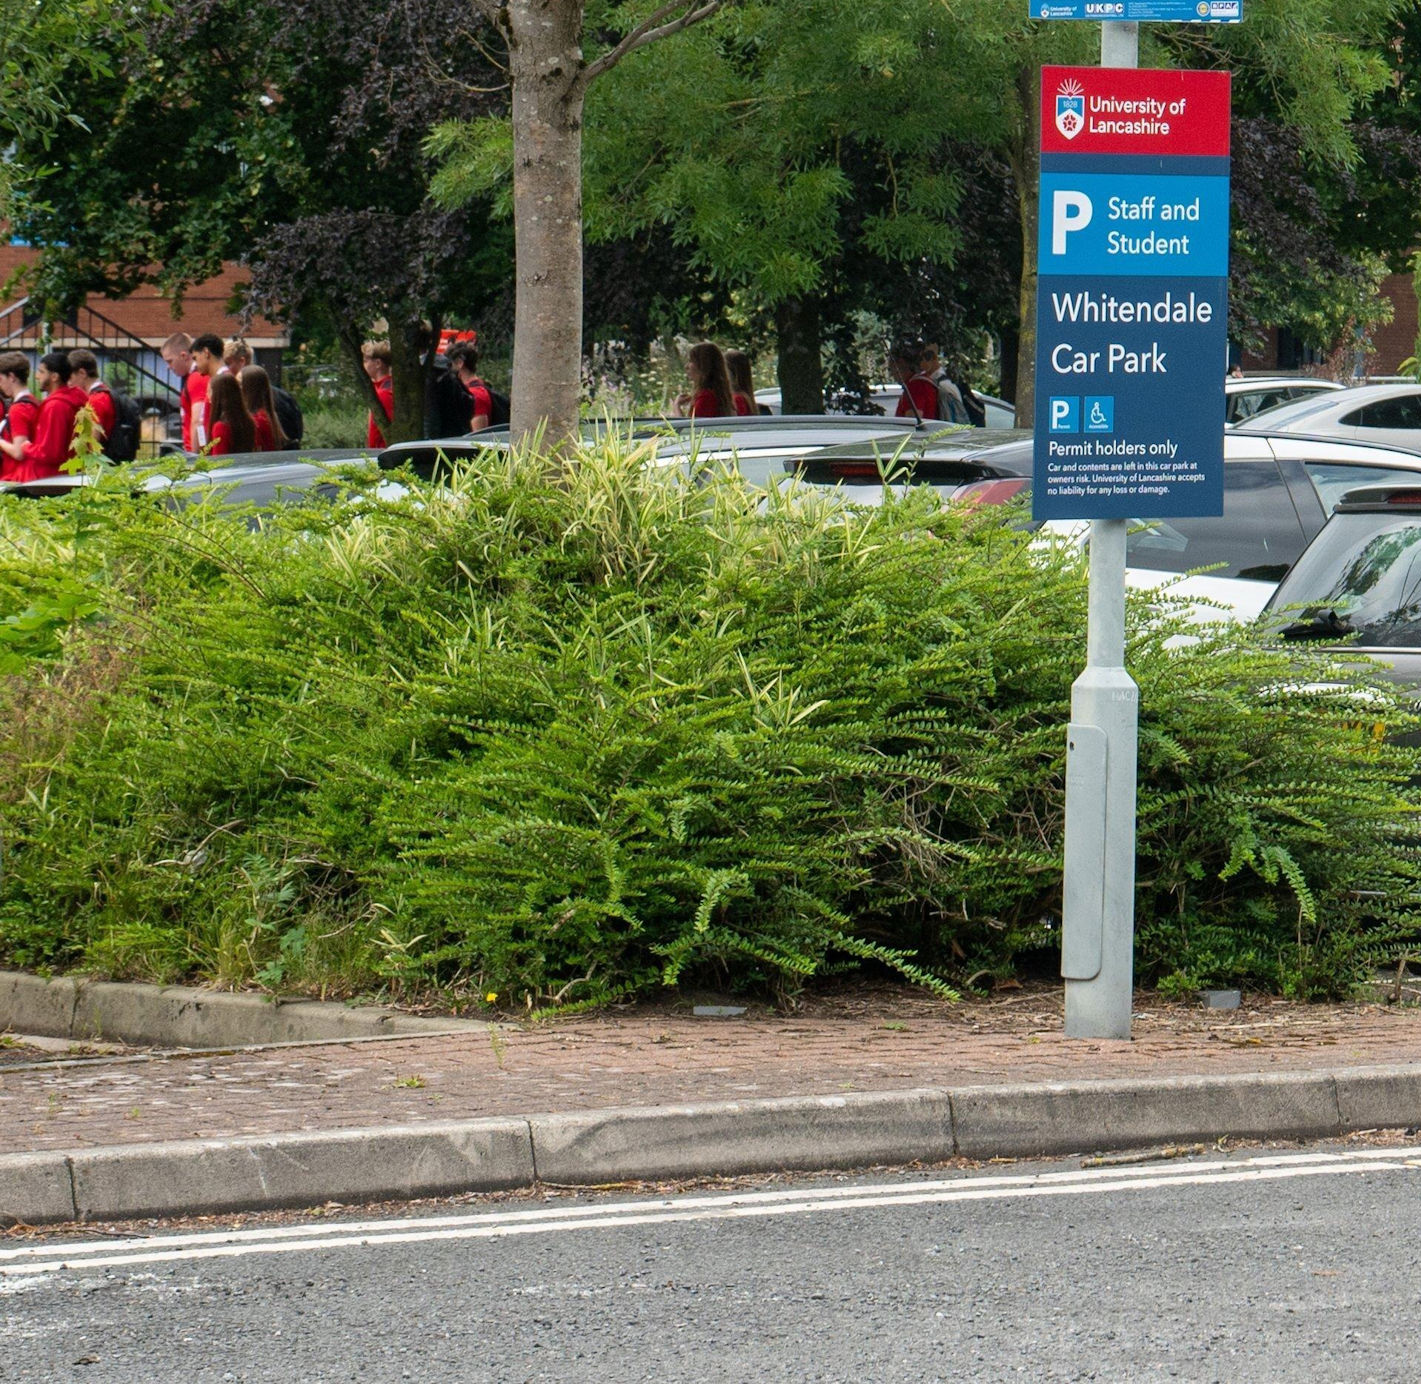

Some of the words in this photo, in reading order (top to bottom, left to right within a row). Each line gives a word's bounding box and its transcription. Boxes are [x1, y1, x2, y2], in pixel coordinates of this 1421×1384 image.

[1086, 3, 1124, 13] UKPC
[1063, 100, 1078, 108] 1828
[1089, 96, 1166, 118] University
[1169, 98, 1187, 115] of
[1089, 117, 1170, 135] Lancashire
[1108, 196, 1156, 220] Staff
[1160, 197, 1200, 220] and
[1052, 190, 1094, 255] P
[1107, 231, 1190, 255] Student
[1052, 291, 1213, 323] Whitendale
[1052, 343, 1100, 374] Car
[1108, 342, 1168, 373] Park
[1052, 400, 1070, 429] P
[1049, 440, 1093, 456] Permit
[1095, 440, 1146, 456] holders
[1150, 440, 1178, 458] only
[1048, 462, 1061, 472] Car
[1062, 462, 1077, 471] and
[1078, 463, 1109, 471] contents
[1124, 462, 1136, 471] left
[1137, 462, 1144, 471] in
[1145, 462, 1158, 470] this
[1173, 462, 1189, 471] park
[1190, 462, 1198, 470] at
[1076, 474, 1091, 483] risk.
[1092, 474, 1128, 484] University
[1129, 473, 1137, 482] of
[1138, 473, 1176, 482] Lancashire
[1178, 474, 1206, 483] accepts
[1059, 485, 1086, 496] liability
[1086, 485, 1097, 494] for
[1099, 487, 1112, 496] any
[1113, 485, 1128, 494] loss
[1138, 485, 1170, 495] damage.
